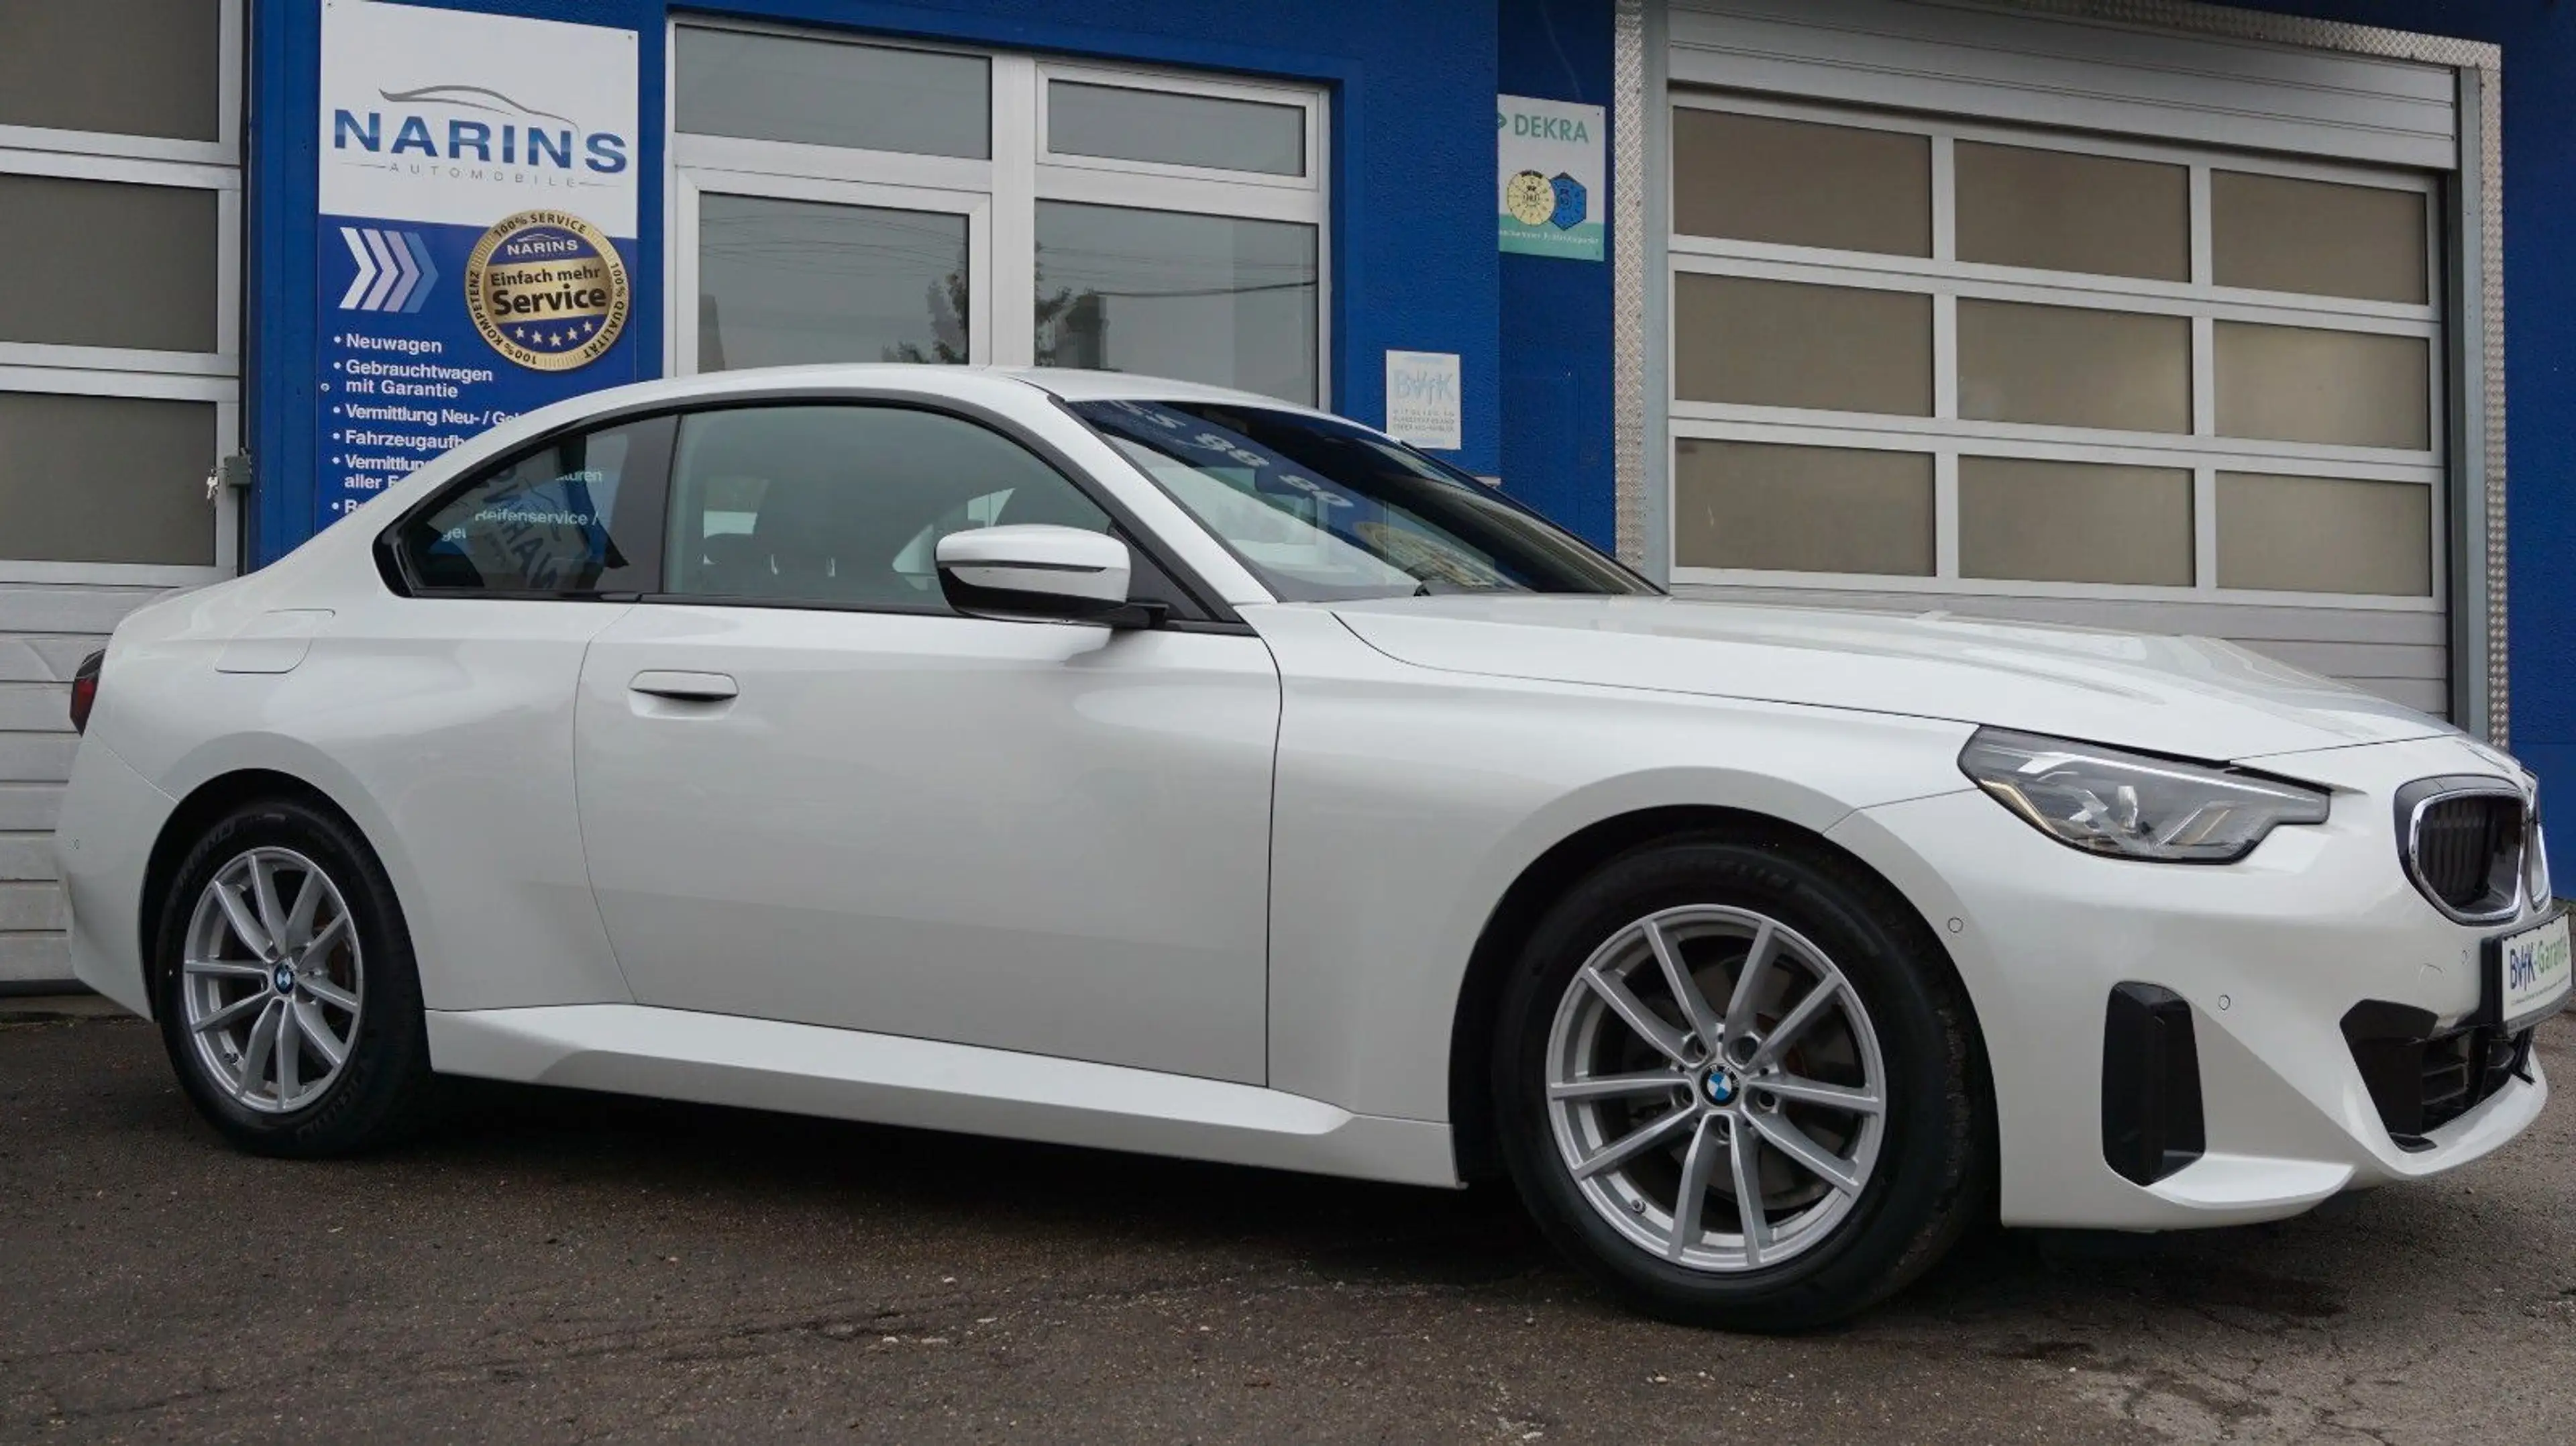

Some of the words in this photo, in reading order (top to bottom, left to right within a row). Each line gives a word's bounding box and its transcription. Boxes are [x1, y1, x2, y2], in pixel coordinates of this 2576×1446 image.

[1514, 113, 1590, 144] DEKRA
[334, 109, 627, 174] NARINS
[388, 163, 574, 188] AUTOMOBILE
[494, 215, 528, 238] 100%
[529, 212, 587, 235] SERVICE
[506, 239, 579, 256] NARINS
[490, 268, 553, 287] Einfach
[556, 265, 601, 282] mehr
[610, 262, 626, 297] 100%
[469, 270, 504, 346] KOMPETENZ
[492, 282, 608, 316] Service
[583, 301, 626, 359] QUALITÄT
[345, 333, 443, 355] Neuwagen
[504, 342, 537, 366] 100%
[345, 359, 493, 384] Gebrauchtwagen
[345, 379, 375, 394] mit
[380, 379, 459, 399] Garantie
[345, 403, 437, 426] Vermittlung
[441, 408, 480, 425] Neu-
[482, 410, 490, 425] /
[345, 453, 429, 472] Vermittlun
[344, 472, 383, 490] aller
